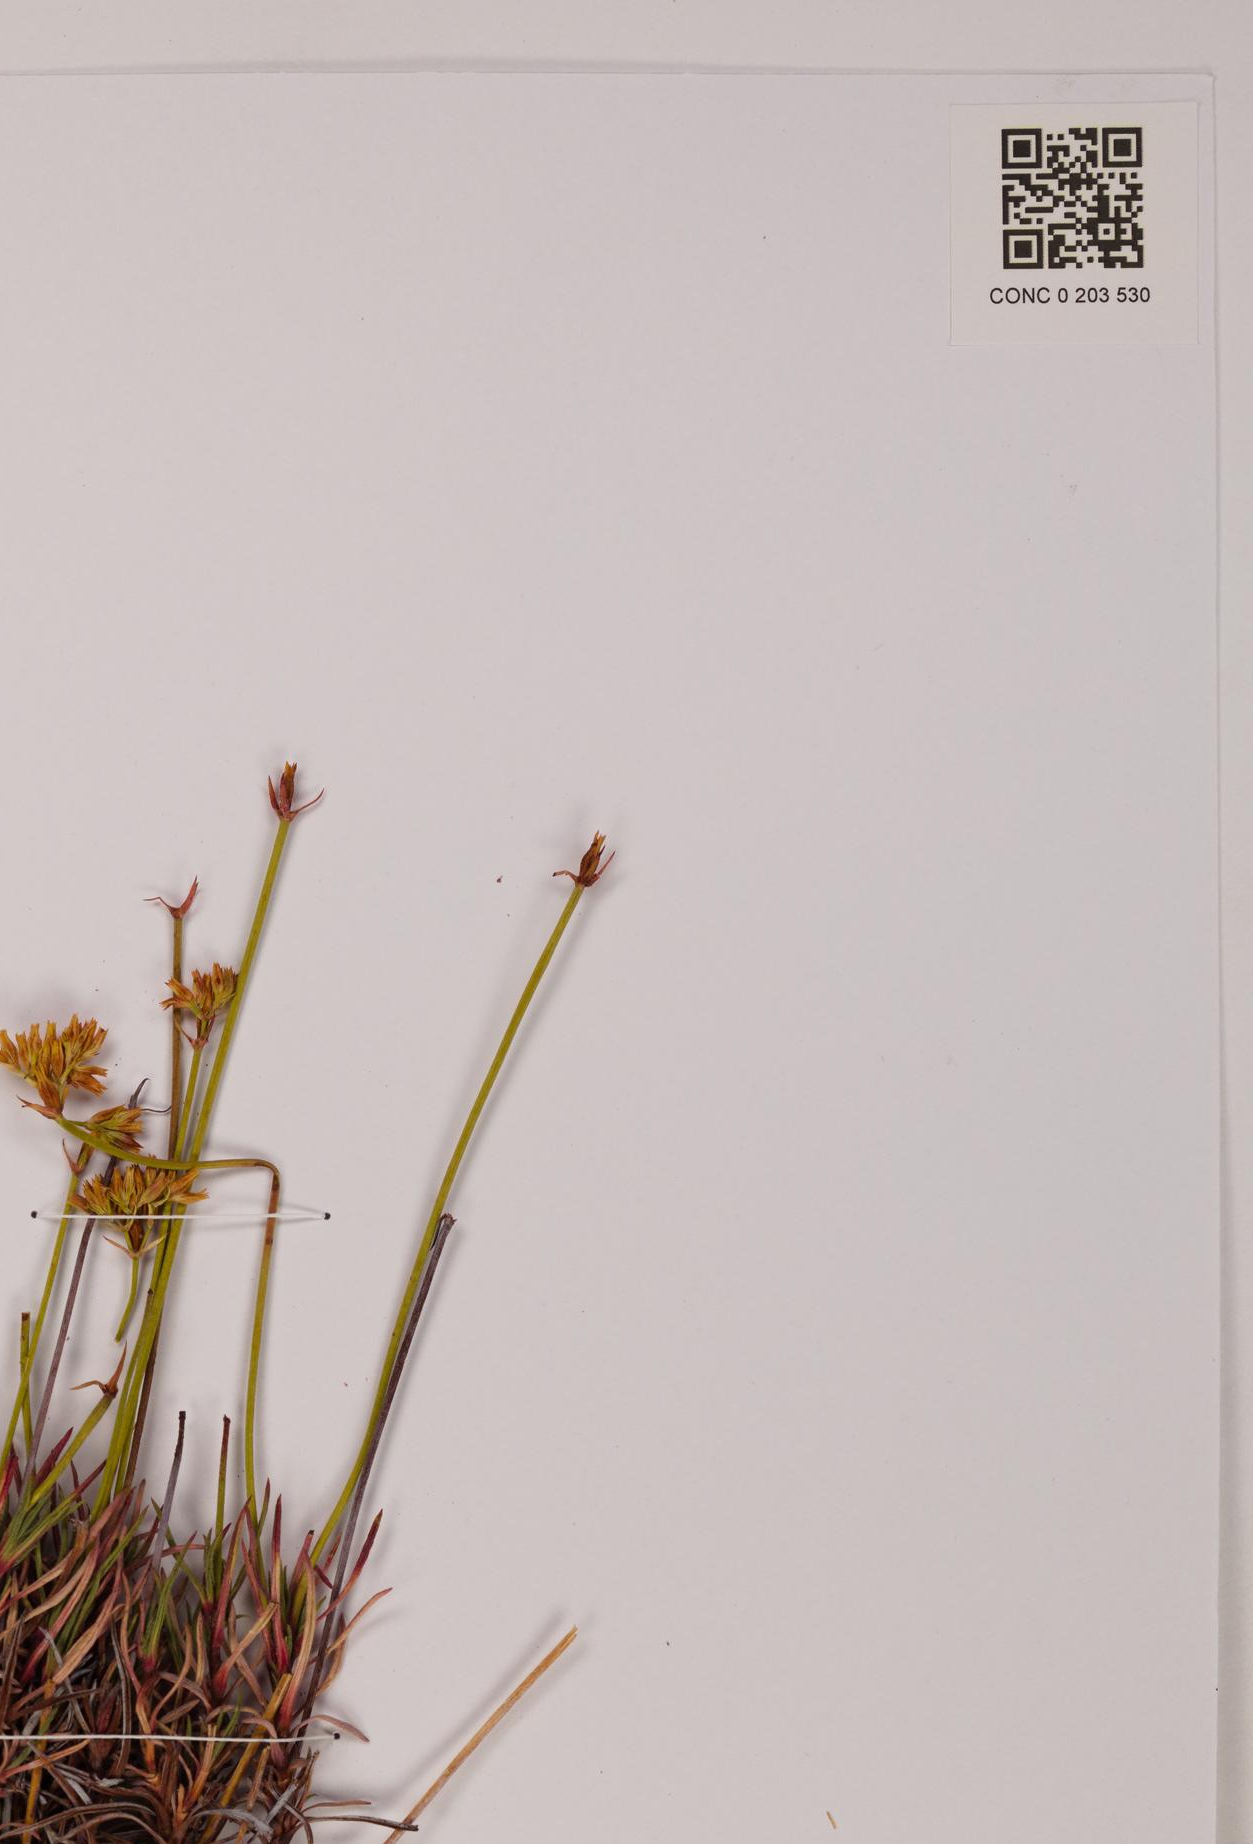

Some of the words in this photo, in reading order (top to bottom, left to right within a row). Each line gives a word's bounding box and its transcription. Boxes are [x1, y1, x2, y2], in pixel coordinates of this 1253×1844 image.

[989, 287, 1051, 304] CONC
[1057, 287, 1069, 304] 0
[1074, 287, 1110, 304] 203
[1116, 286, 1151, 303] 530
